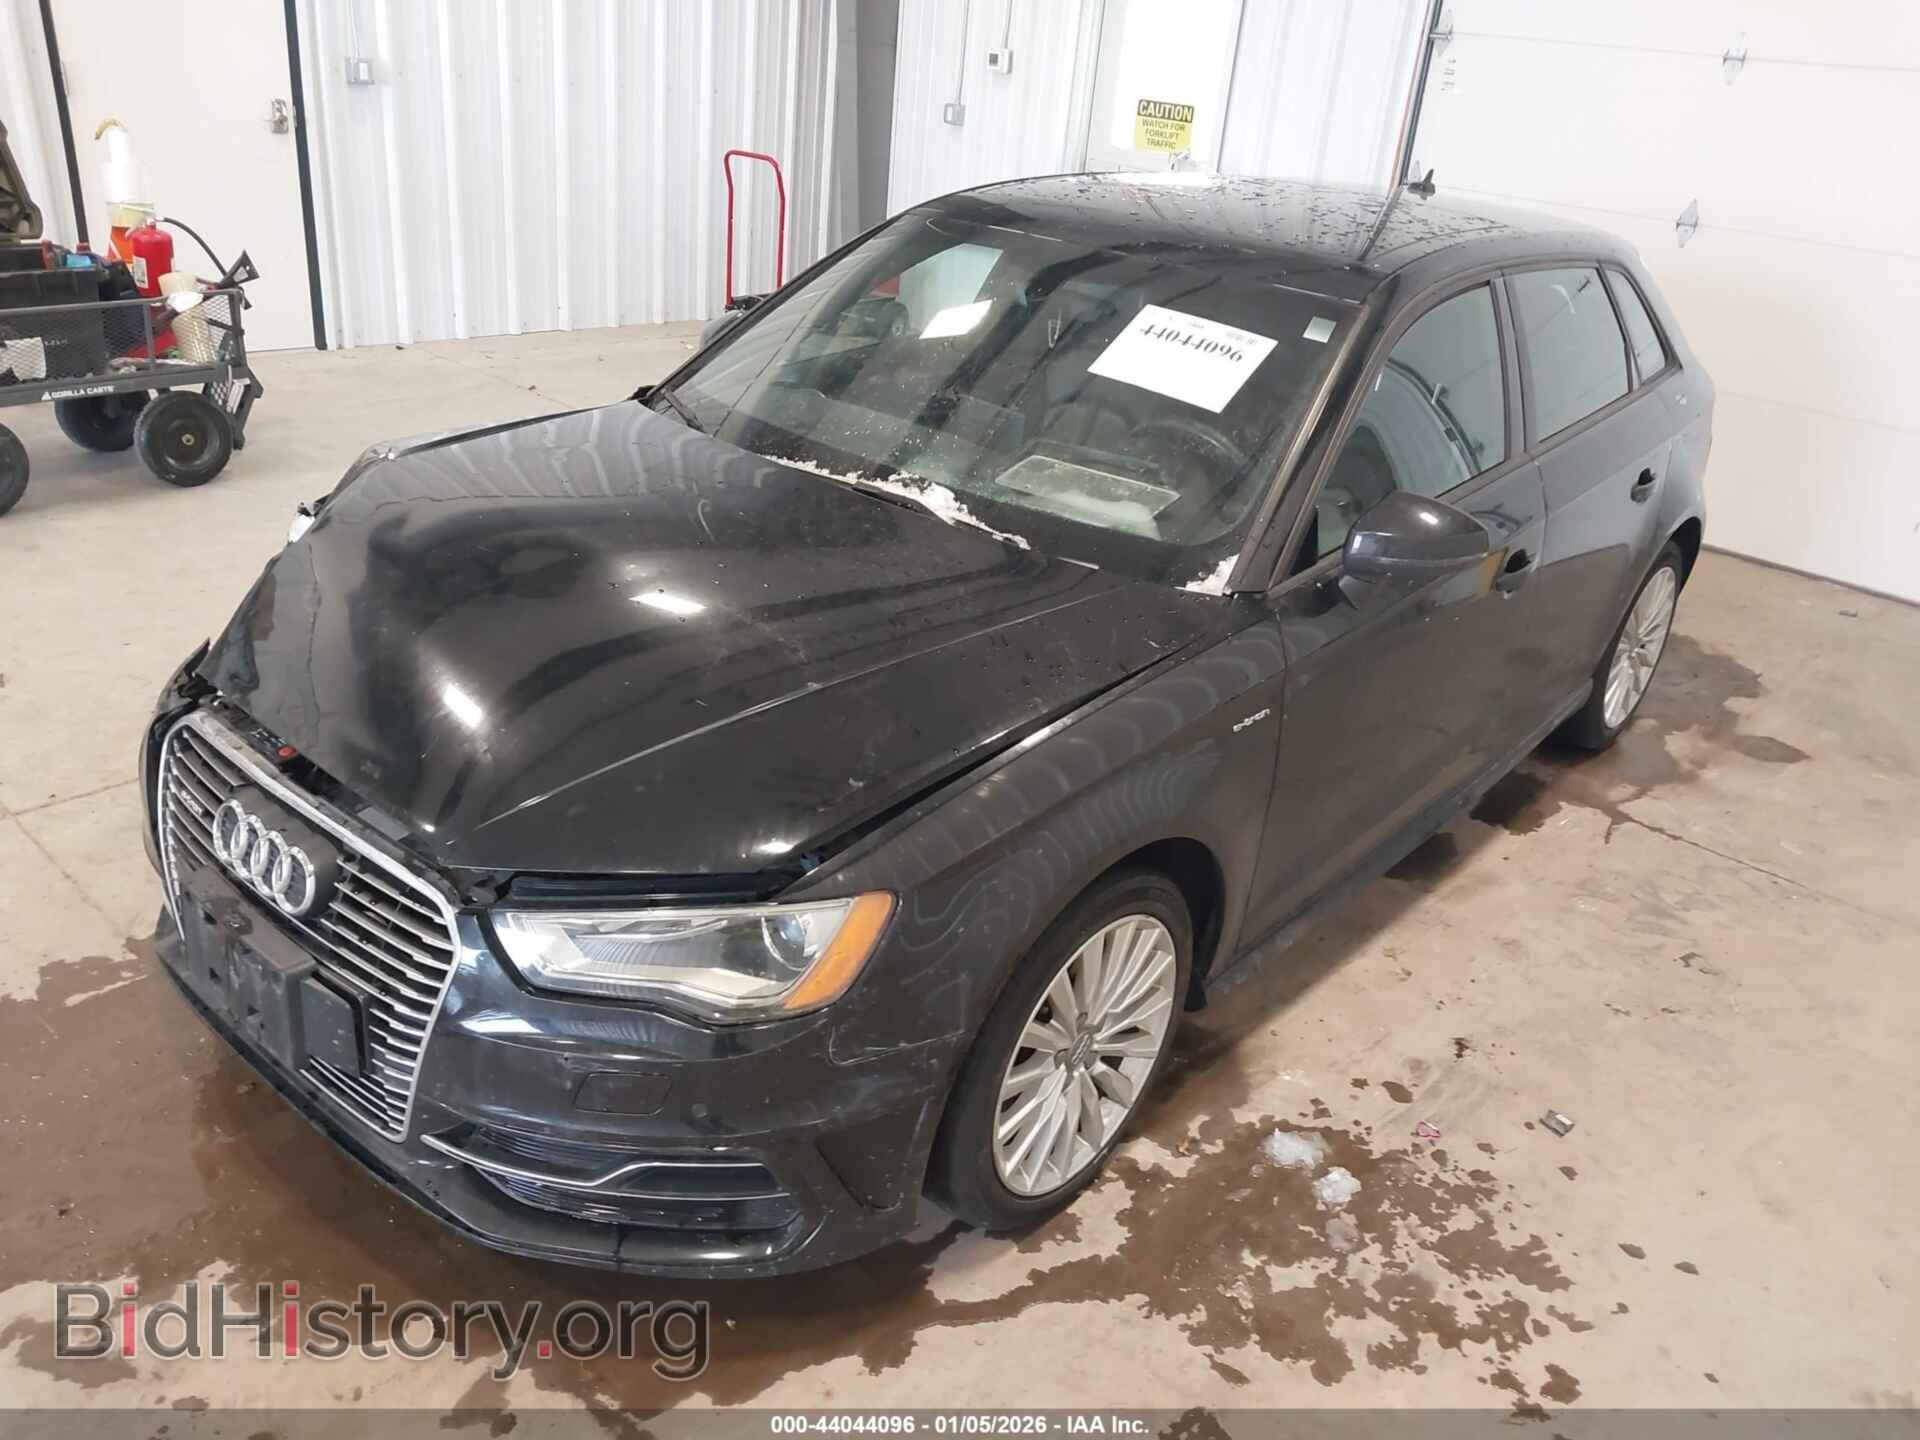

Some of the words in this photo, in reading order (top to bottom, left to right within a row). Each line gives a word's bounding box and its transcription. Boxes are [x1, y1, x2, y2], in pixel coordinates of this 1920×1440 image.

[1139, 101, 1193, 121] CAUTION
[1142, 119, 1169, 129] WATCH
[1170, 122, 1186, 132] FOR
[1145, 128, 1180, 140] FORKLIFT
[1146, 138, 1177, 149] TRAFFIC
[1139, 323, 1243, 363] 44044096
